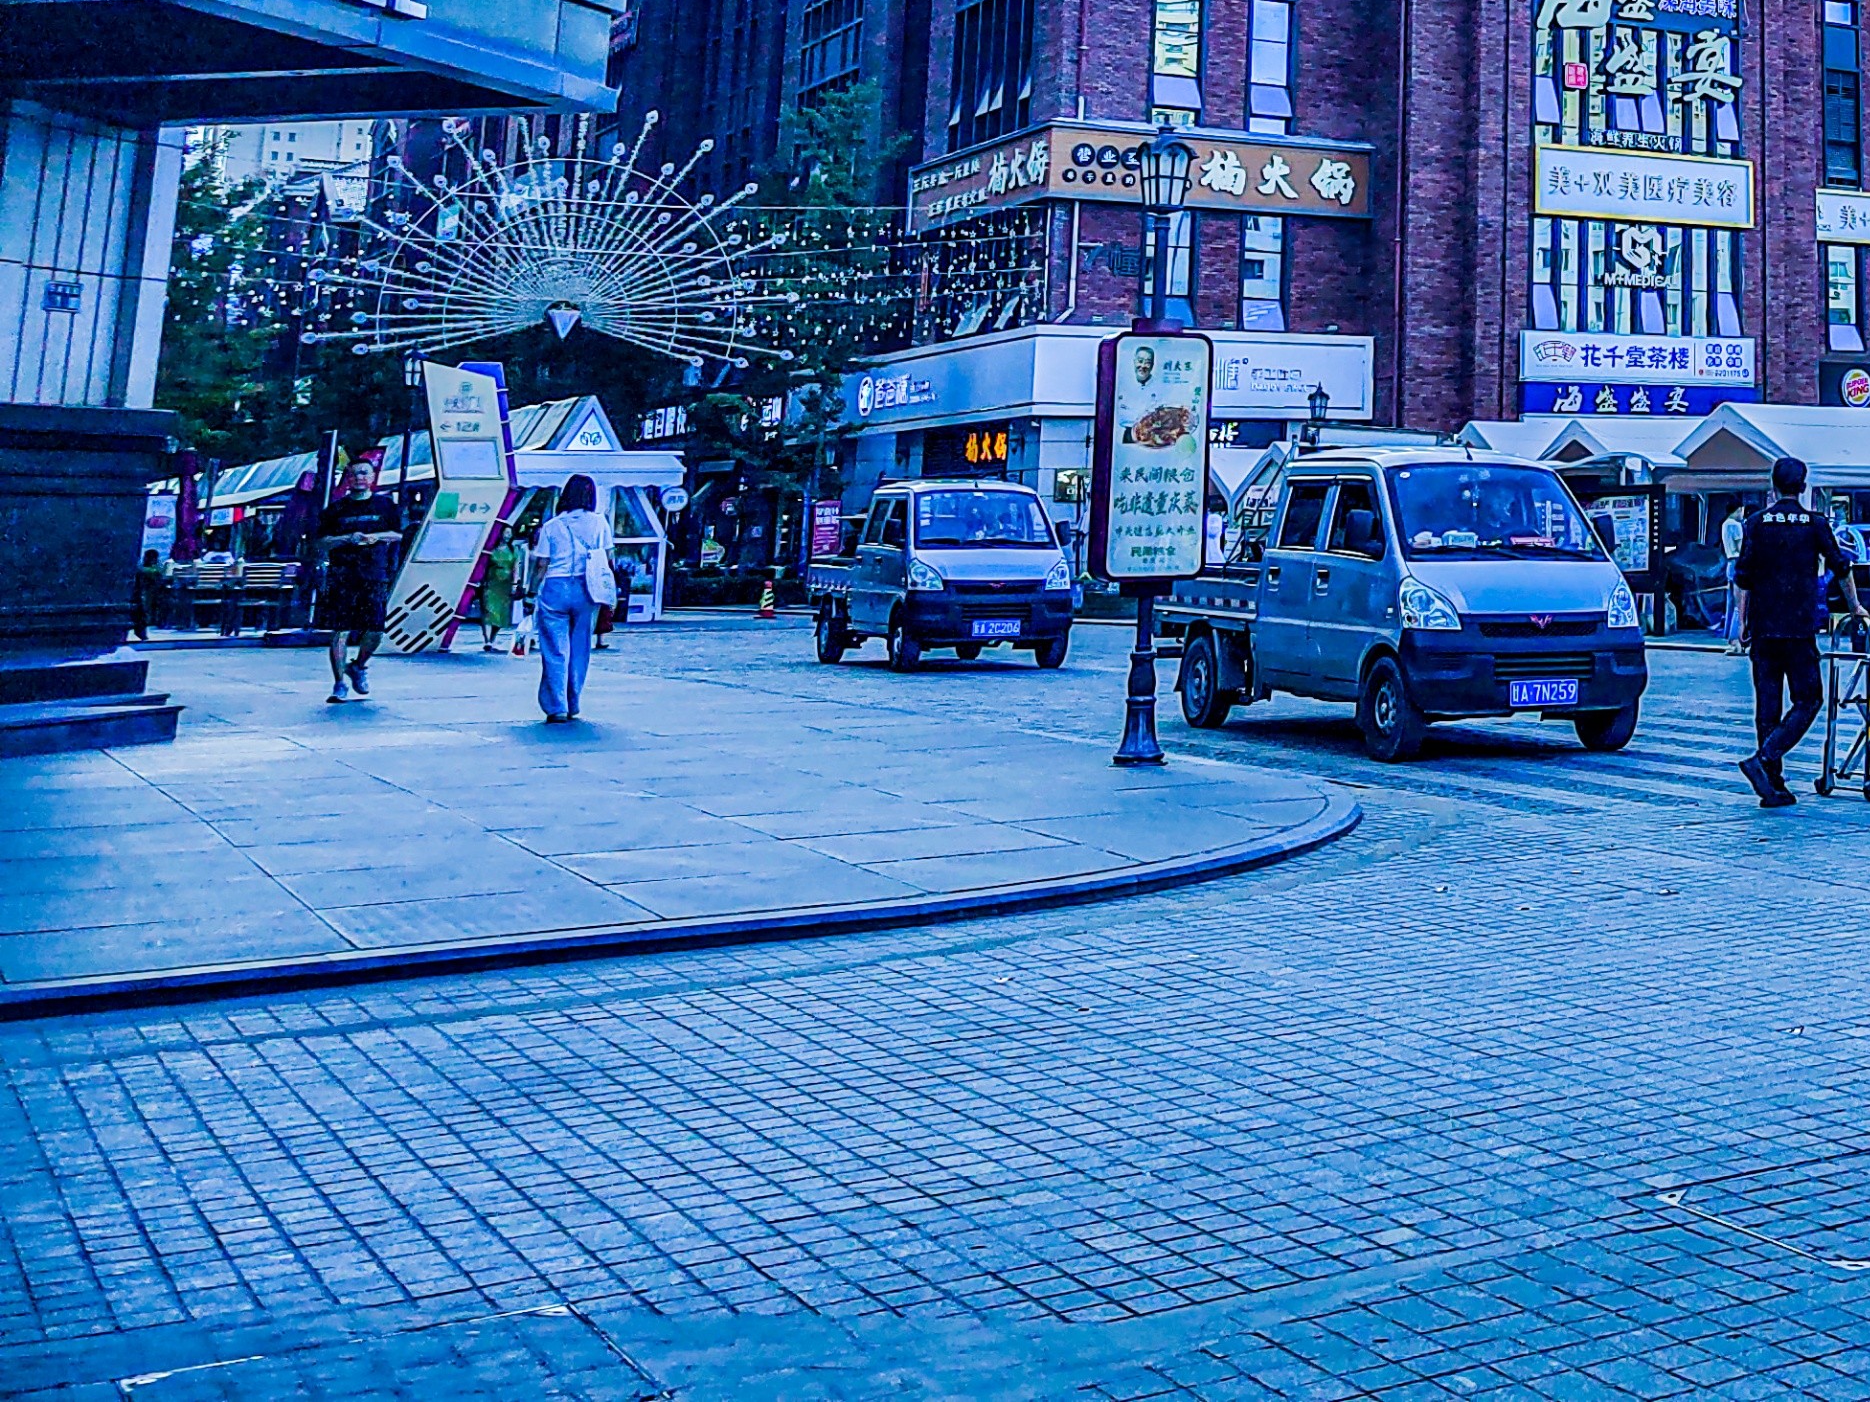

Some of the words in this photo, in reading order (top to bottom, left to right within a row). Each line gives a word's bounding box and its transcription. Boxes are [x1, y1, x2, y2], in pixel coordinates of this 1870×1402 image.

[1580, 344, 1689, 369] 花千堂茶楼
[1848, 384, 1870, 398] KING
